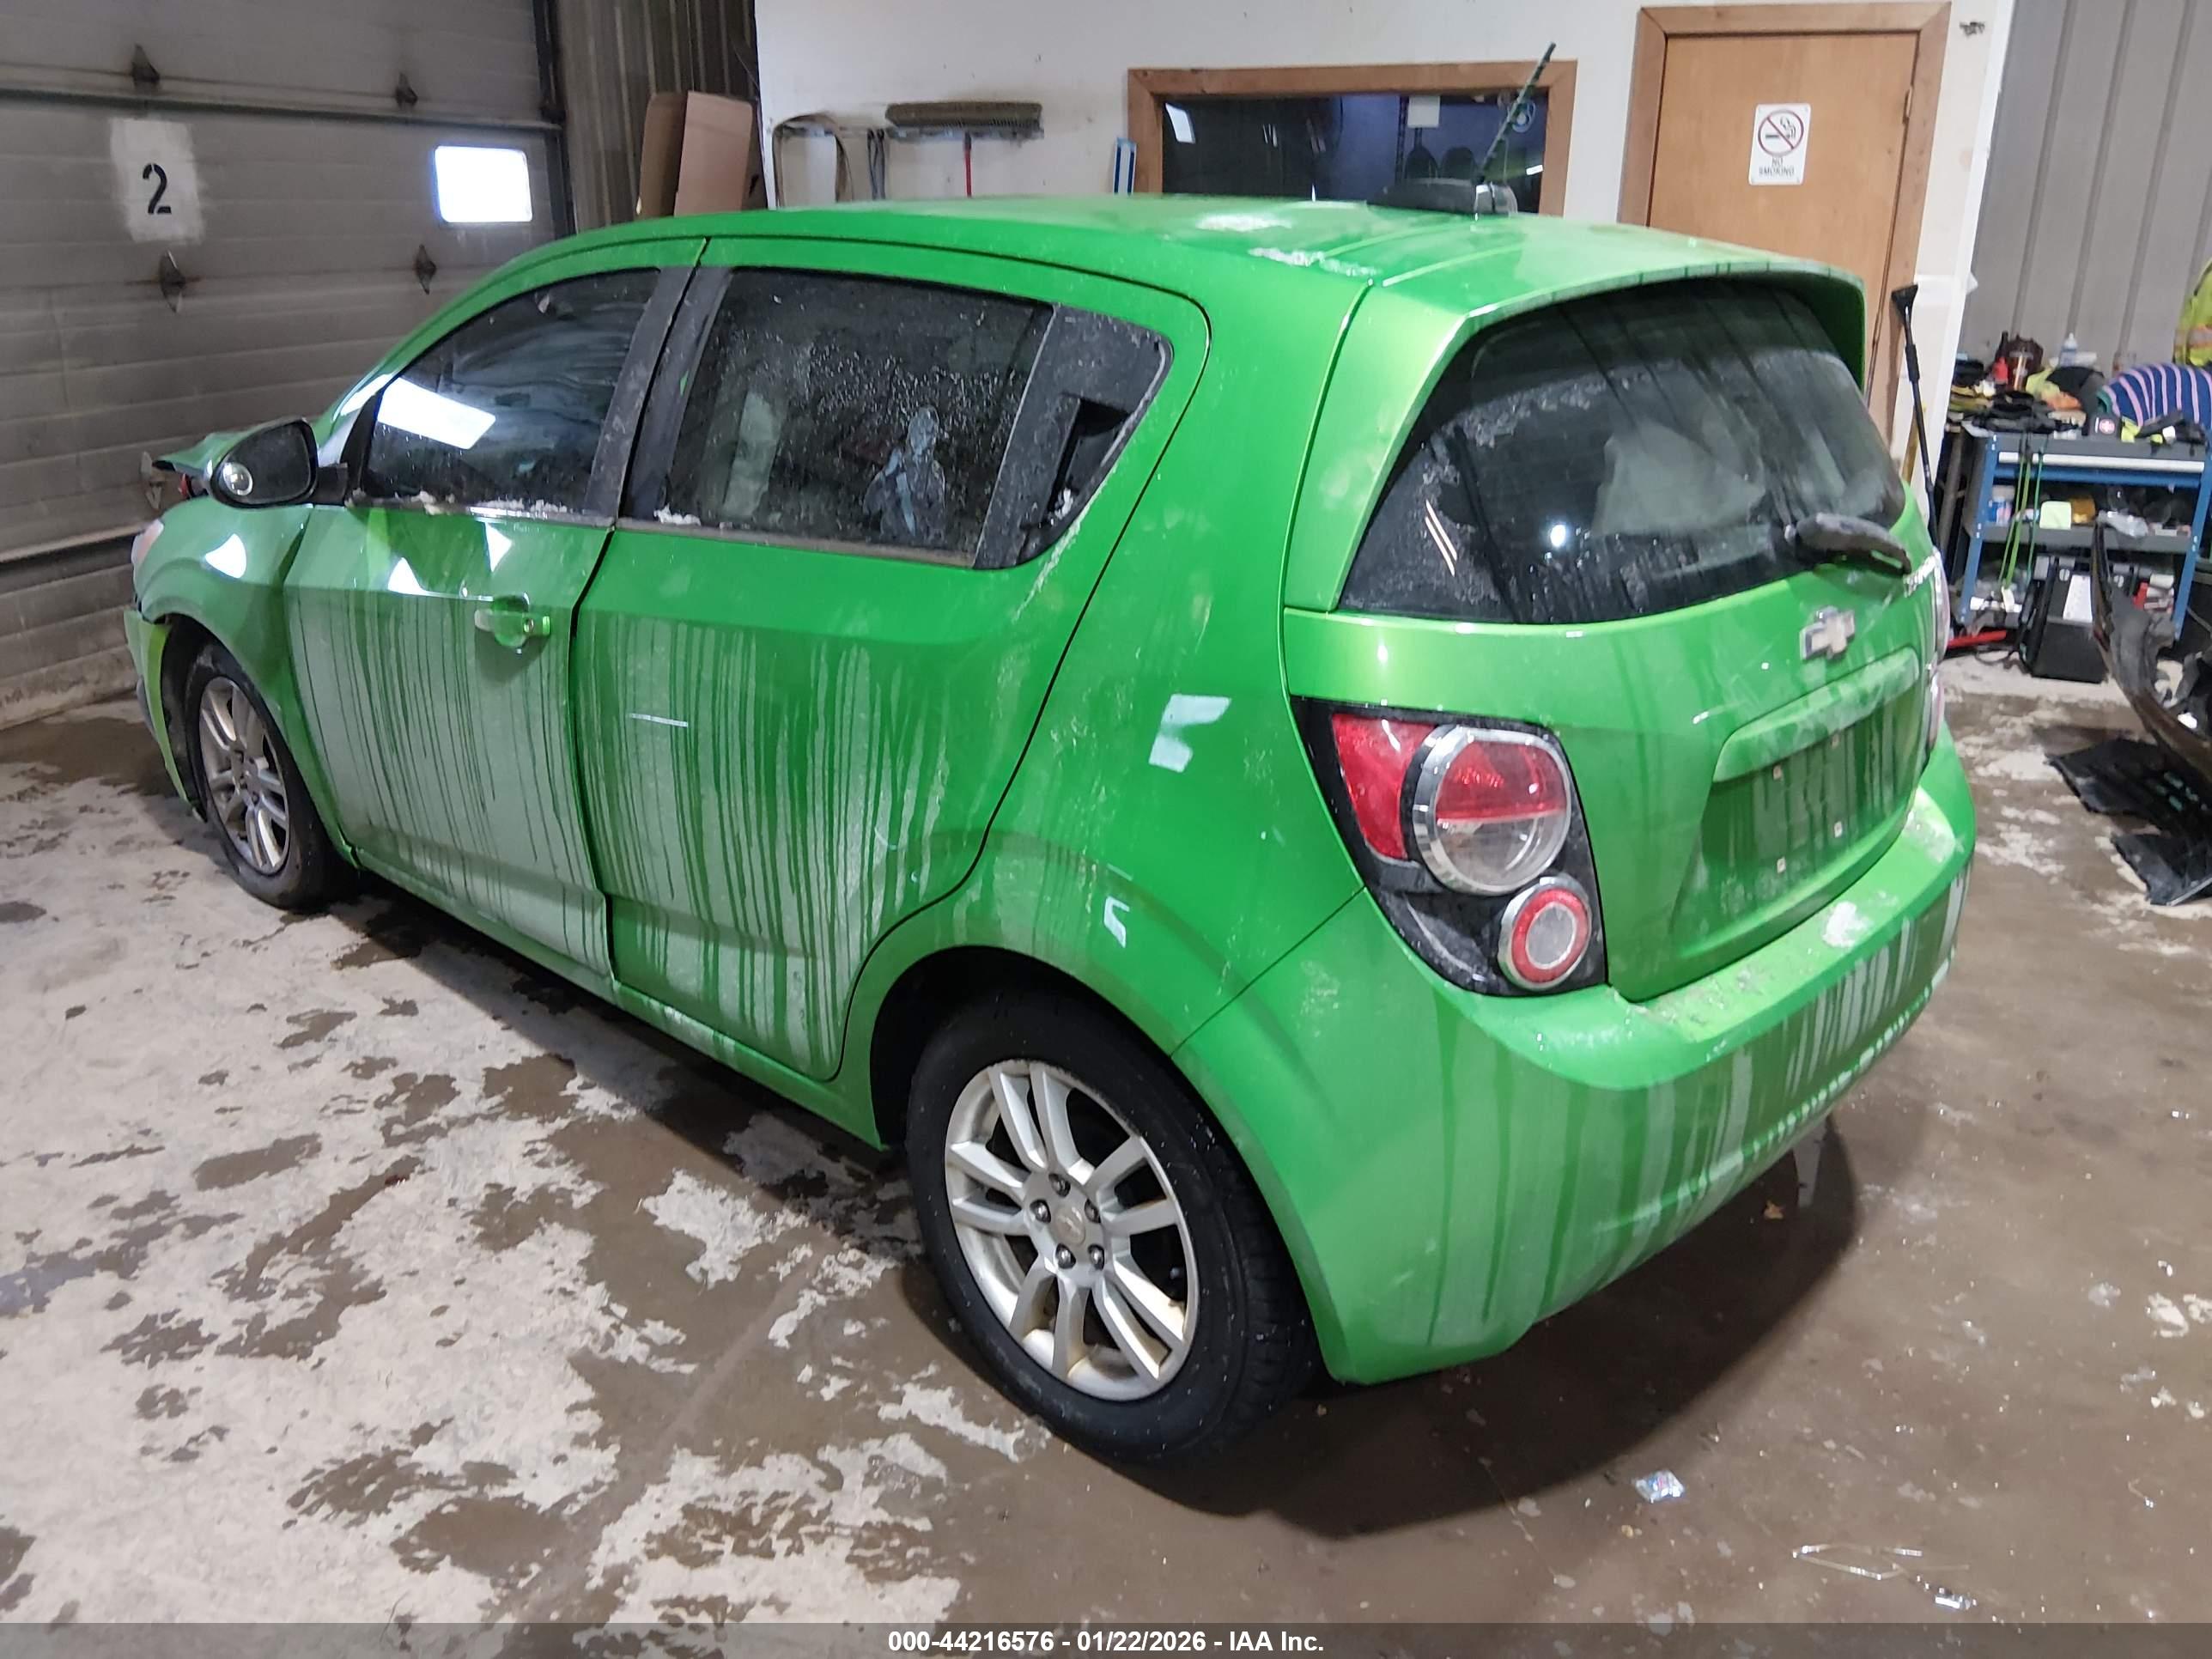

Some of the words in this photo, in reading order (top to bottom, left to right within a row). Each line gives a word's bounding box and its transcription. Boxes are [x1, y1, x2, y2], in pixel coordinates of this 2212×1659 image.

[1771, 157, 1784, 167] NO
[1759, 167, 1795, 177] SMOKING
[142, 163, 172, 215] 2
